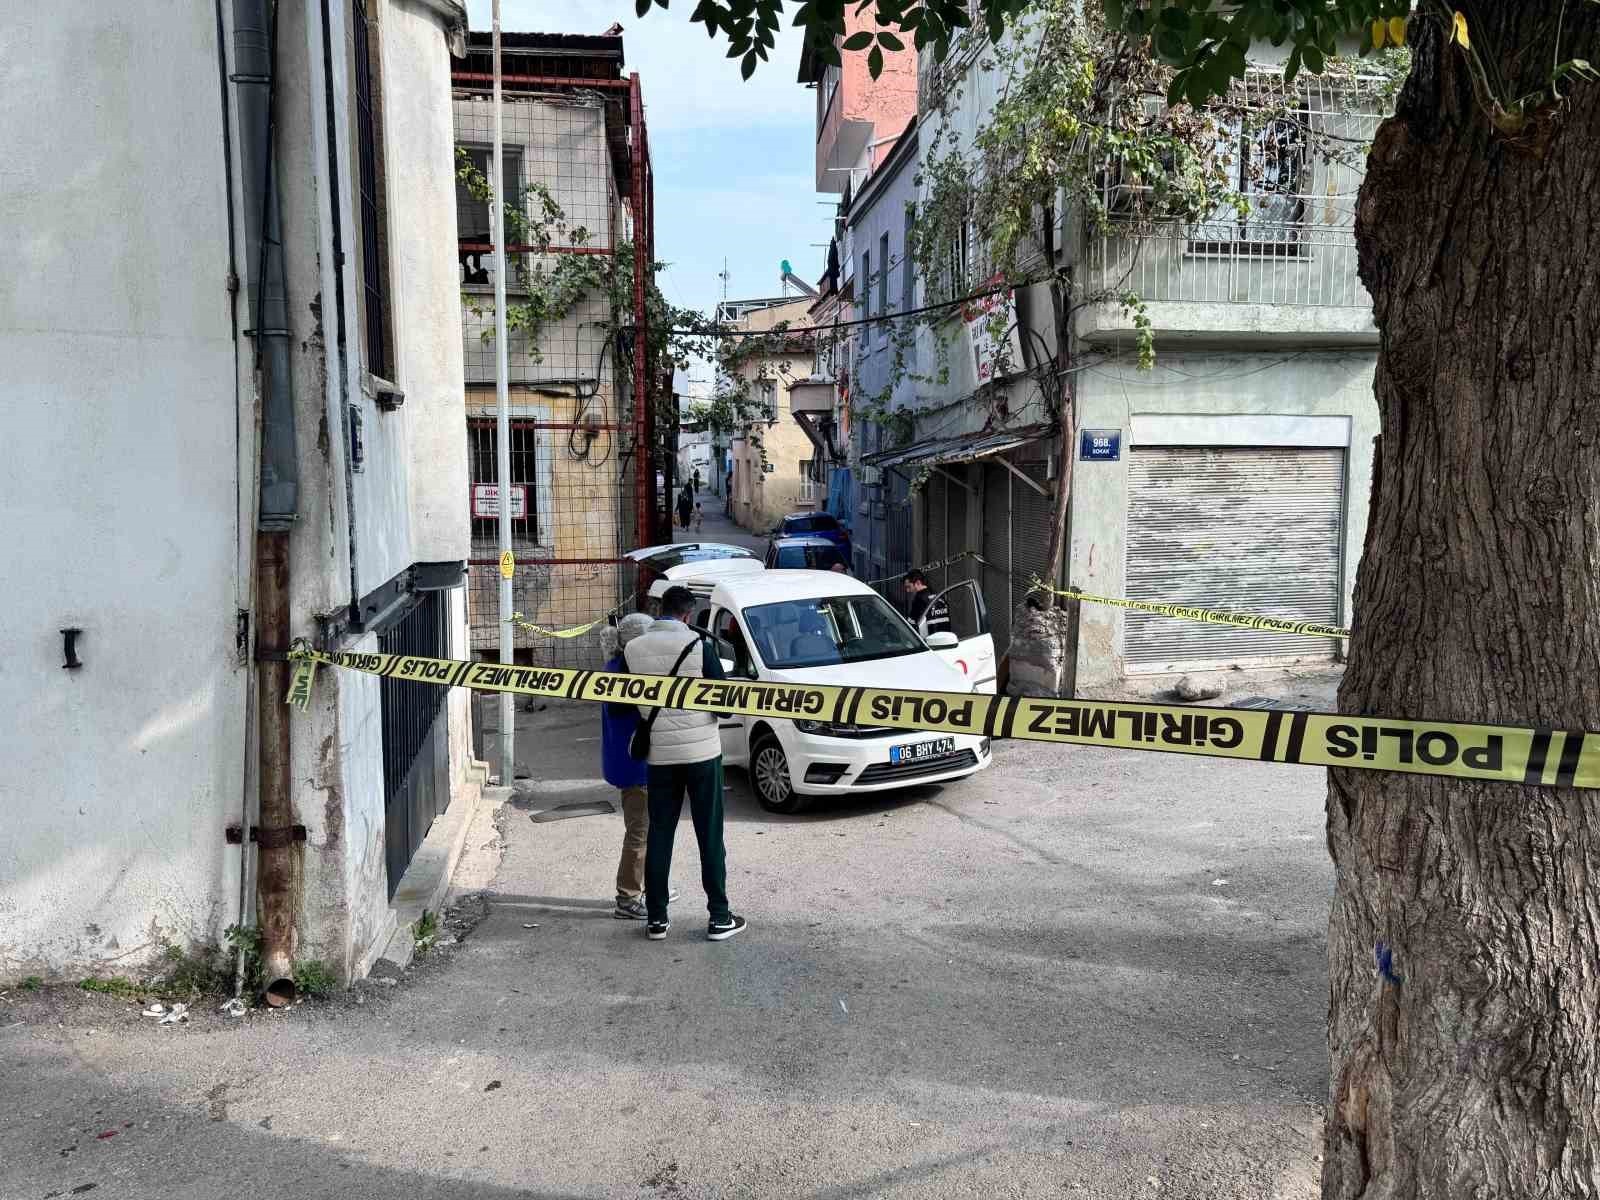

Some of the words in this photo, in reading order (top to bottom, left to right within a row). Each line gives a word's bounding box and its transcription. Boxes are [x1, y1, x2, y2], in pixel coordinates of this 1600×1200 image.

[400, 659, 452, 680] POLİS
[471, 666, 565, 690] GİRİLMEZ
[593, 676, 663, 700] POLİS
[694, 683, 825, 714] GİRİLMEZ
[871, 695, 973, 727] POLİS
[1028, 704, 1244, 748] GİRİLMEZ
[899, 747, 912, 760] 06
[916, 743, 934, 757] BHY
[1325, 724, 1503, 771] POLİS
